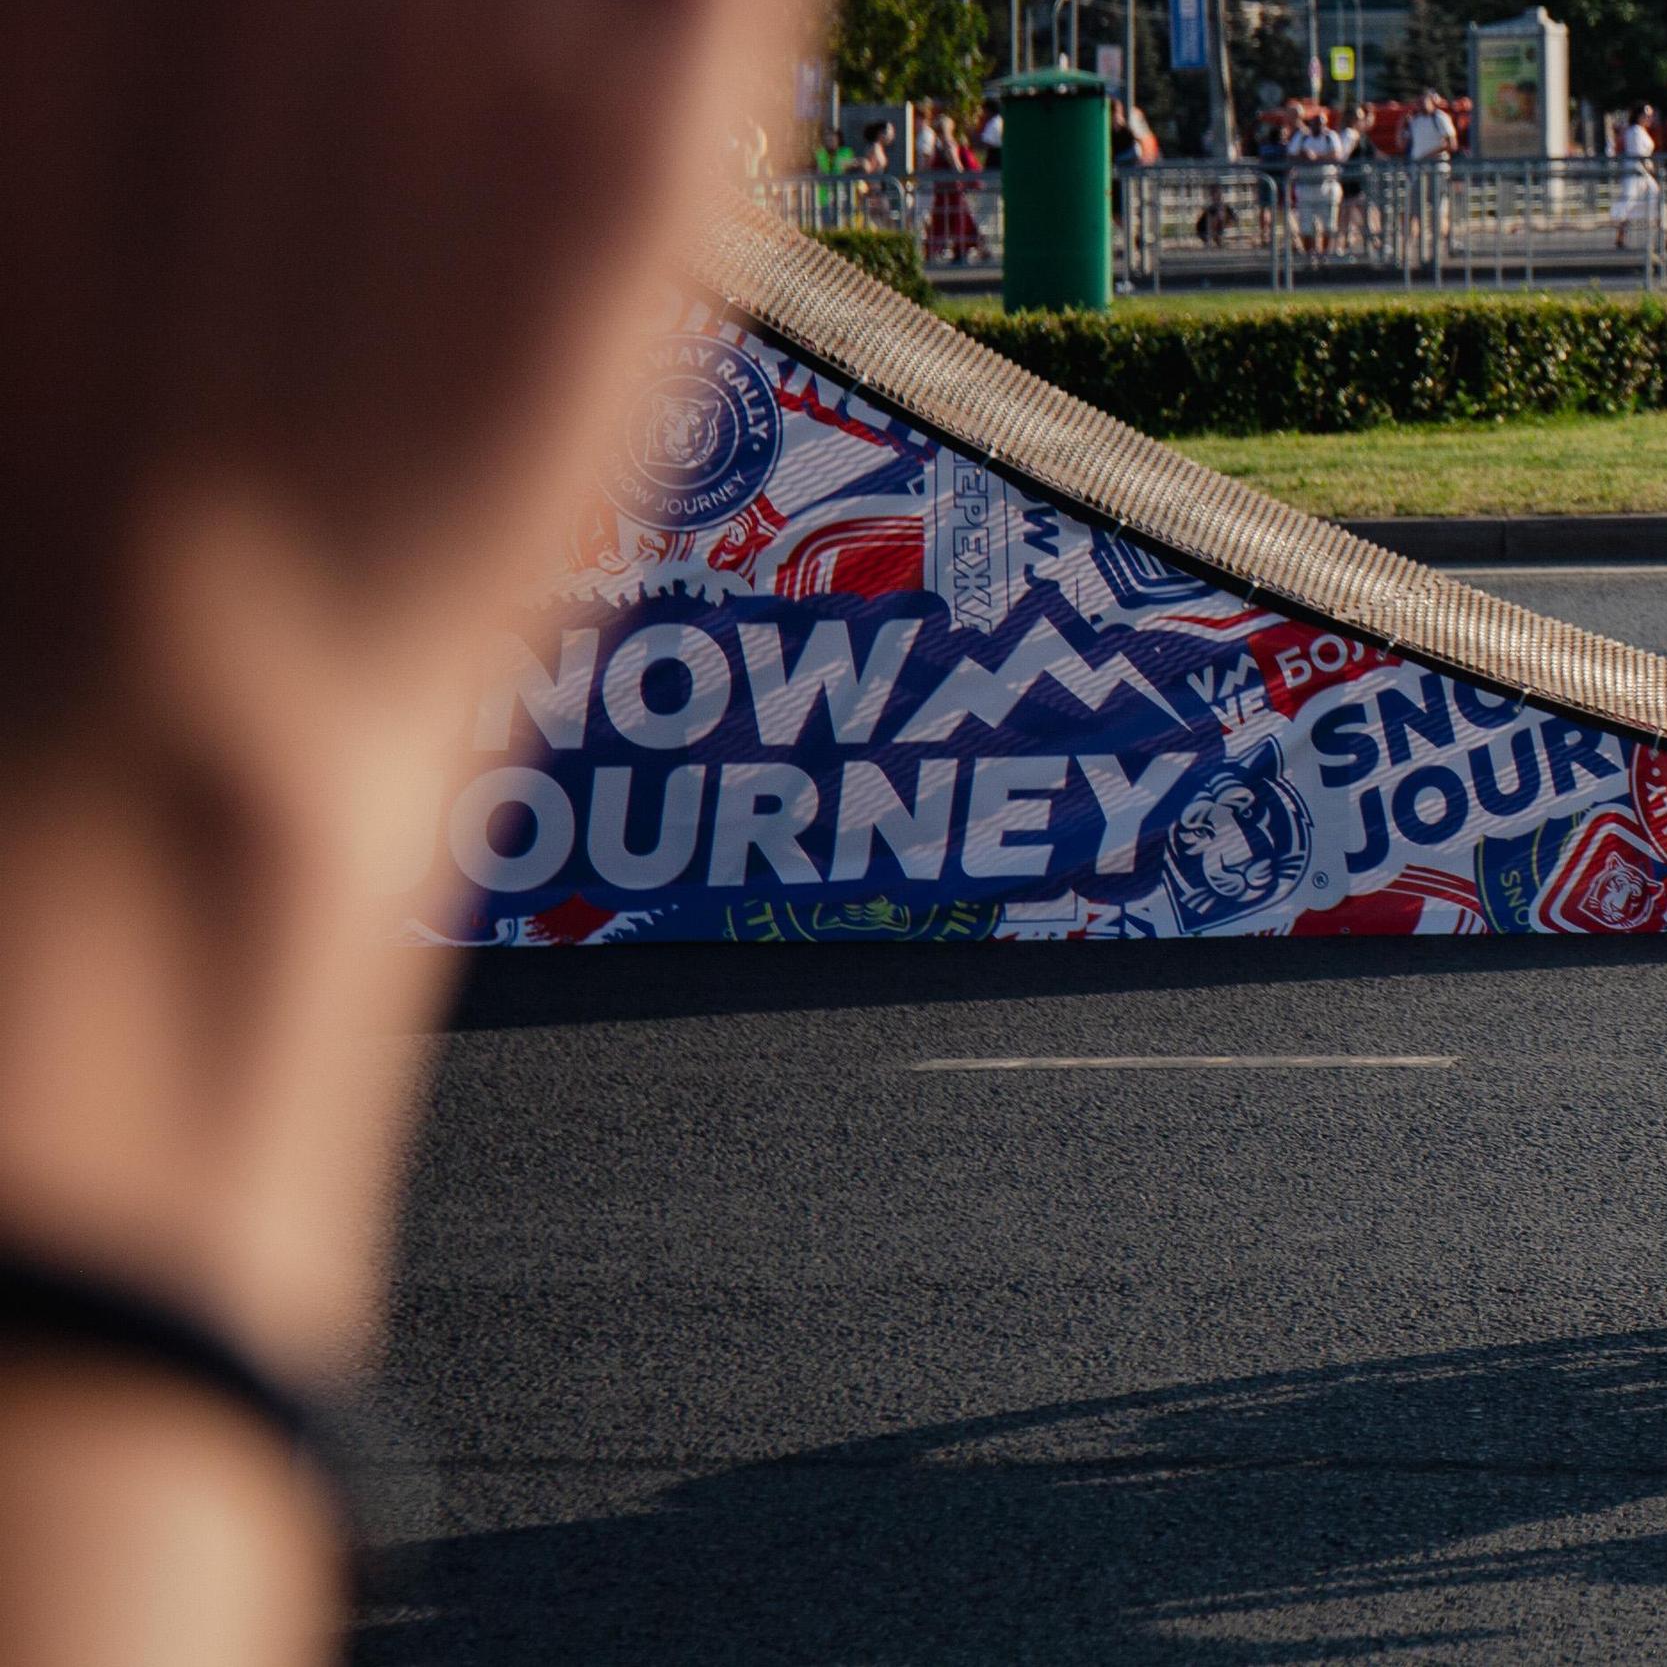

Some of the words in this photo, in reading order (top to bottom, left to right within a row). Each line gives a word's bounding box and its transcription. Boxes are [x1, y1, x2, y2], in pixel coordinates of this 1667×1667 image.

[716, 358, 769, 440] RALLY
[655, 469, 747, 516] JOURNEY
[446, 752, 1198, 893] OURNEY
[1344, 717, 1630, 873] JOUR
